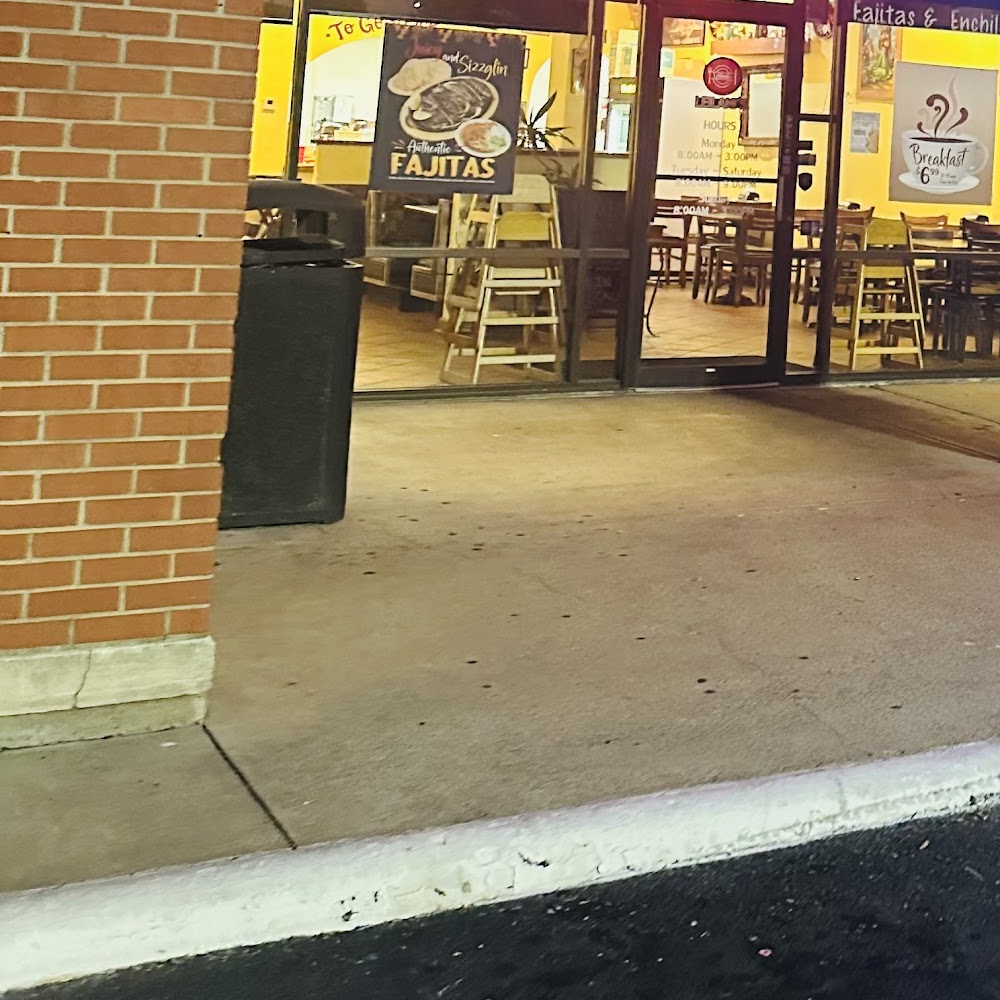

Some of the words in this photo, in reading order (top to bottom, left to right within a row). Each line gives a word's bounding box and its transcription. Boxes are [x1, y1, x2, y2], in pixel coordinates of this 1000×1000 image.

[853, 0, 915, 26] Fajitas
[923, 7, 938, 28] &
[442, 51, 460, 63] and
[703, 119, 737, 131] HOURS
[701, 138, 736, 150] Monday
[909, 143, 970, 169] Breakfast
[389, 152, 496, 179] FAJITAS
[723, 166, 762, 178] Saturday
